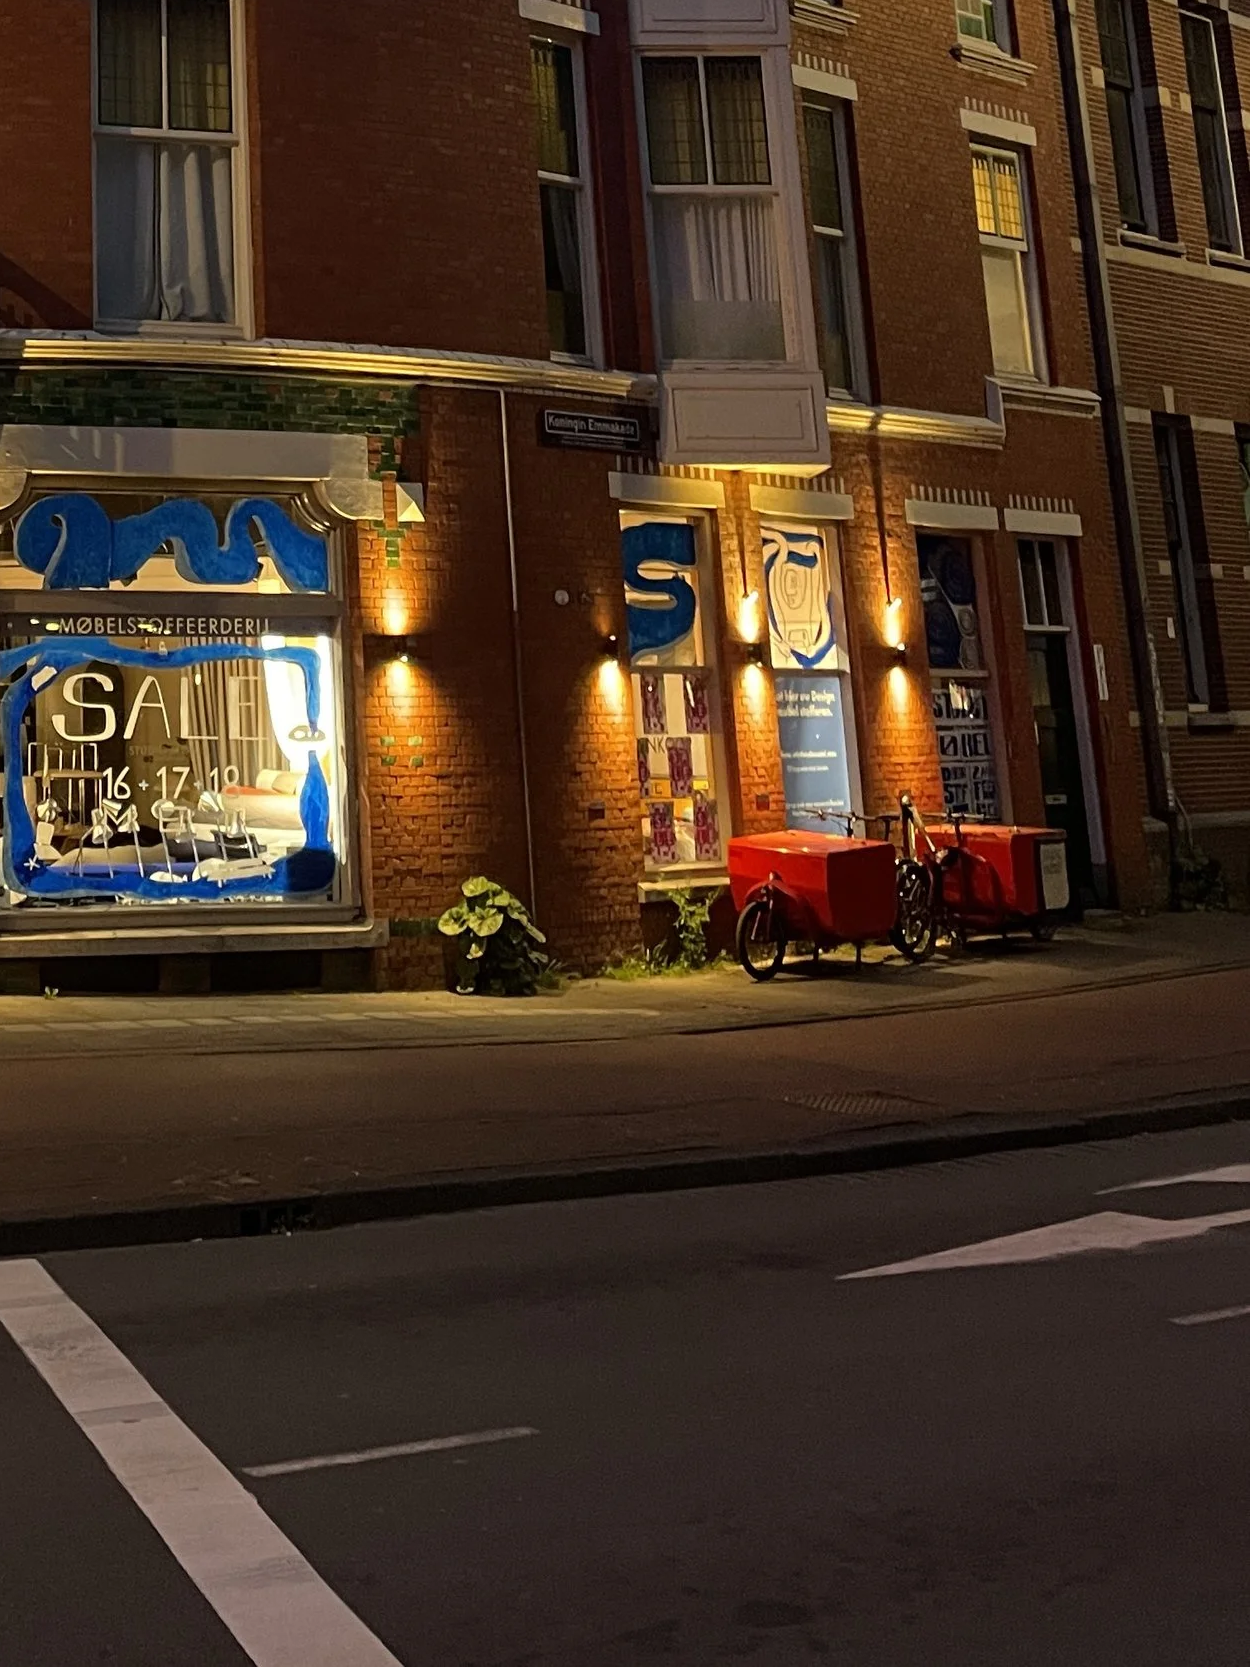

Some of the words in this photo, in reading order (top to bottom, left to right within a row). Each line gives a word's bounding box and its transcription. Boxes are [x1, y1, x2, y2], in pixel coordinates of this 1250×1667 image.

[51, 671, 269, 742] SALE
[103, 766, 132, 800] 16
[156, 766, 191, 800] 17
